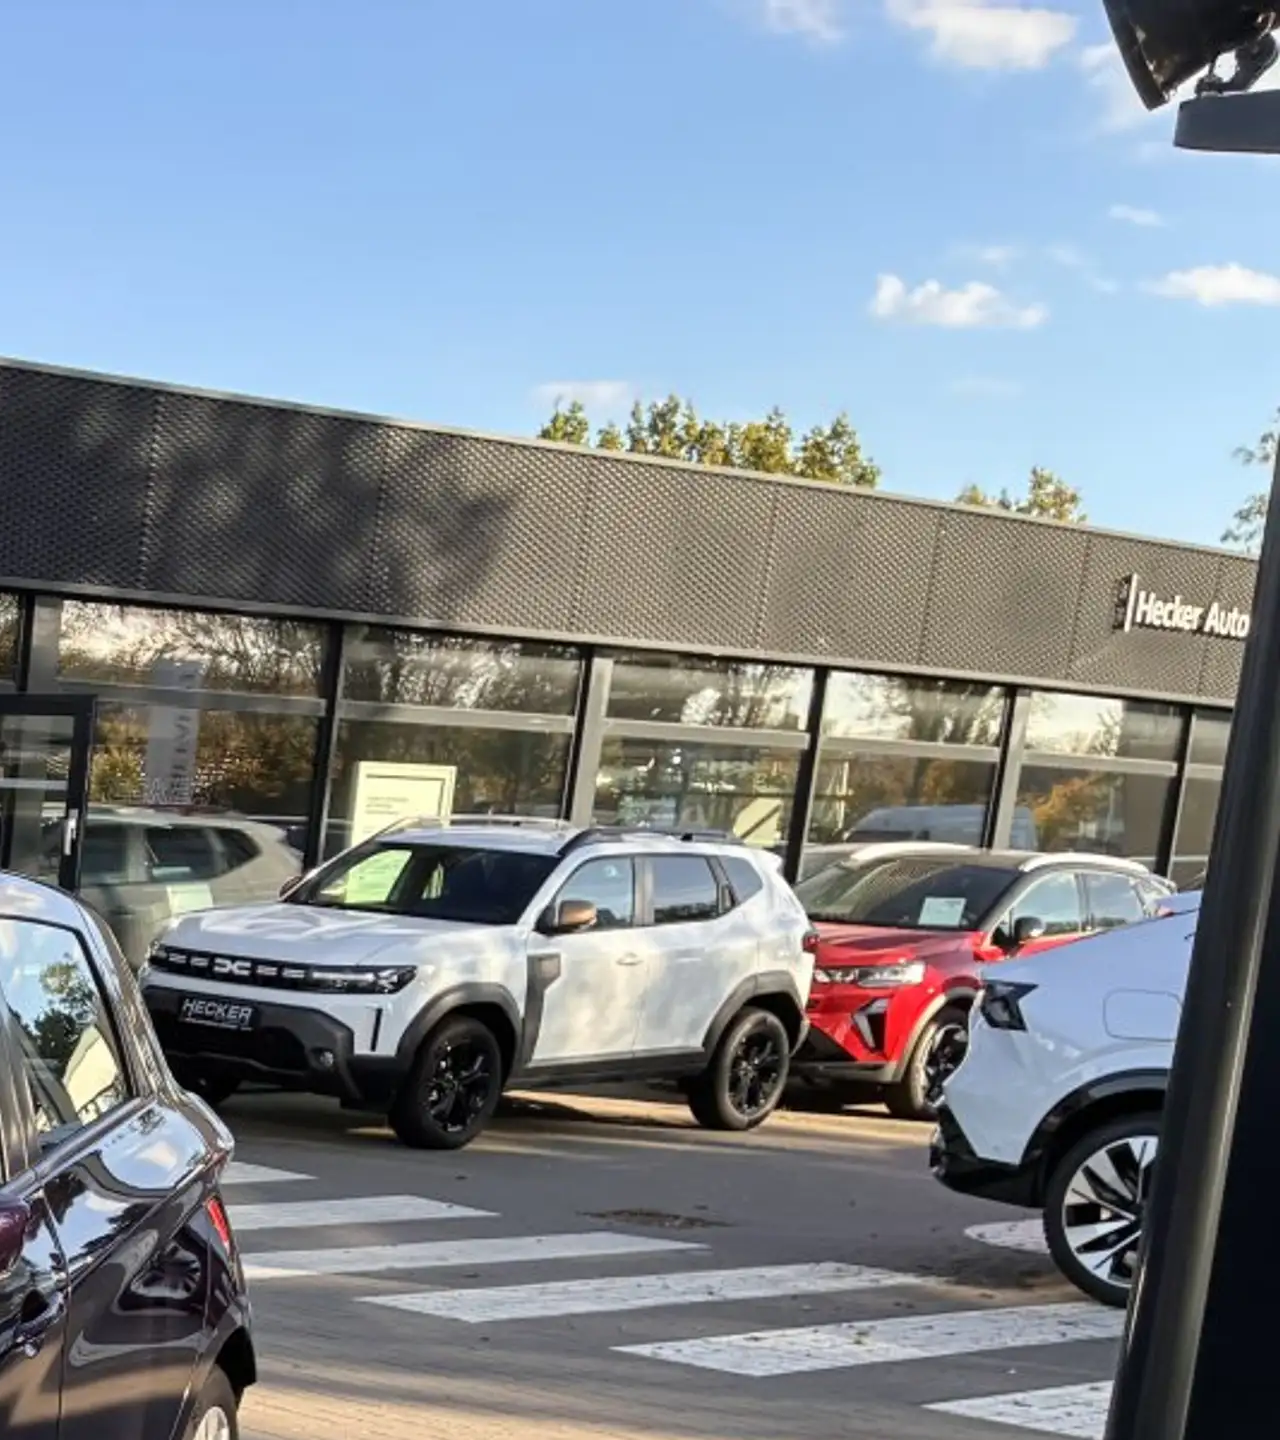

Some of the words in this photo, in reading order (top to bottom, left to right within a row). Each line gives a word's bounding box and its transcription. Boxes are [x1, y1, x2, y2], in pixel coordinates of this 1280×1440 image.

[1135, 590, 1205, 630] Hecker
[1203, 602, 1250, 638] Auto
[182, 998, 253, 1023] HECKER
